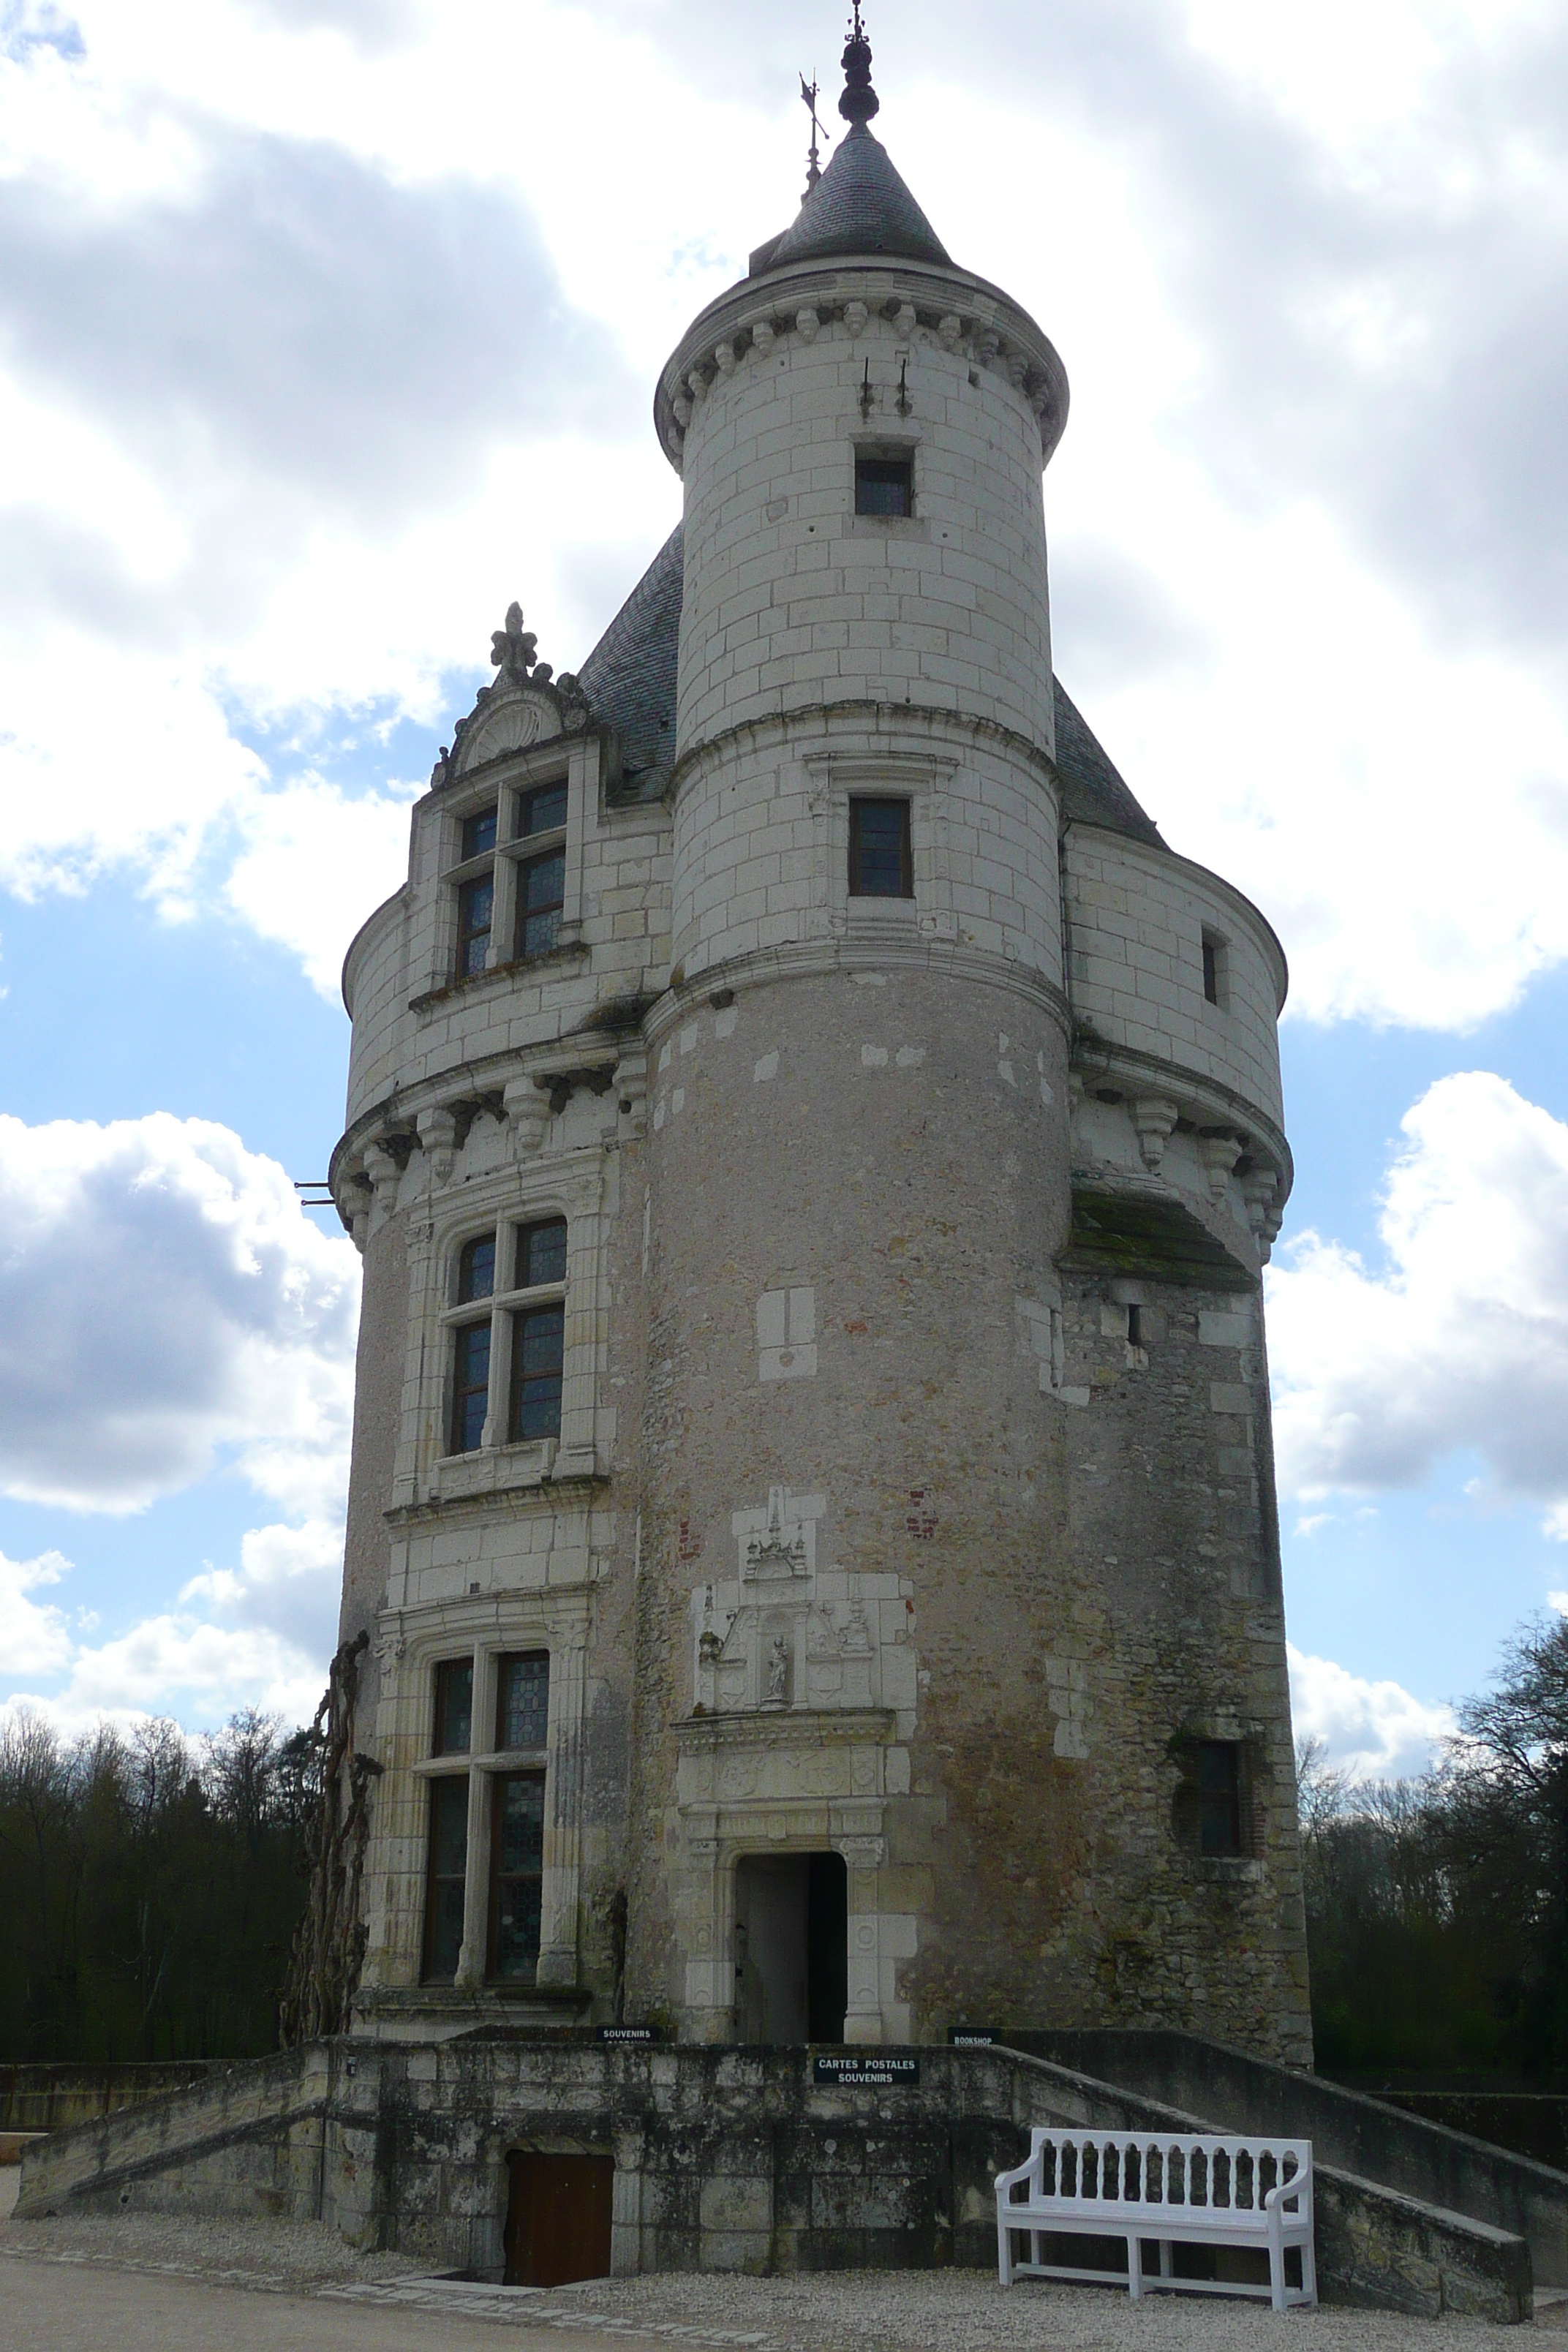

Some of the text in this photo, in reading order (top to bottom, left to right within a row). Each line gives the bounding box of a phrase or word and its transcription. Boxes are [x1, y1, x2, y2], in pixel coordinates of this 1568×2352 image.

[603, 2029, 651, 2038] SOUVENIRS
[954, 2036, 992, 2046] BOOKSHOP
[818, 2059, 916, 2070] CARTES POSTALES
[838, 2073, 893, 2083] SOUVENIRS
